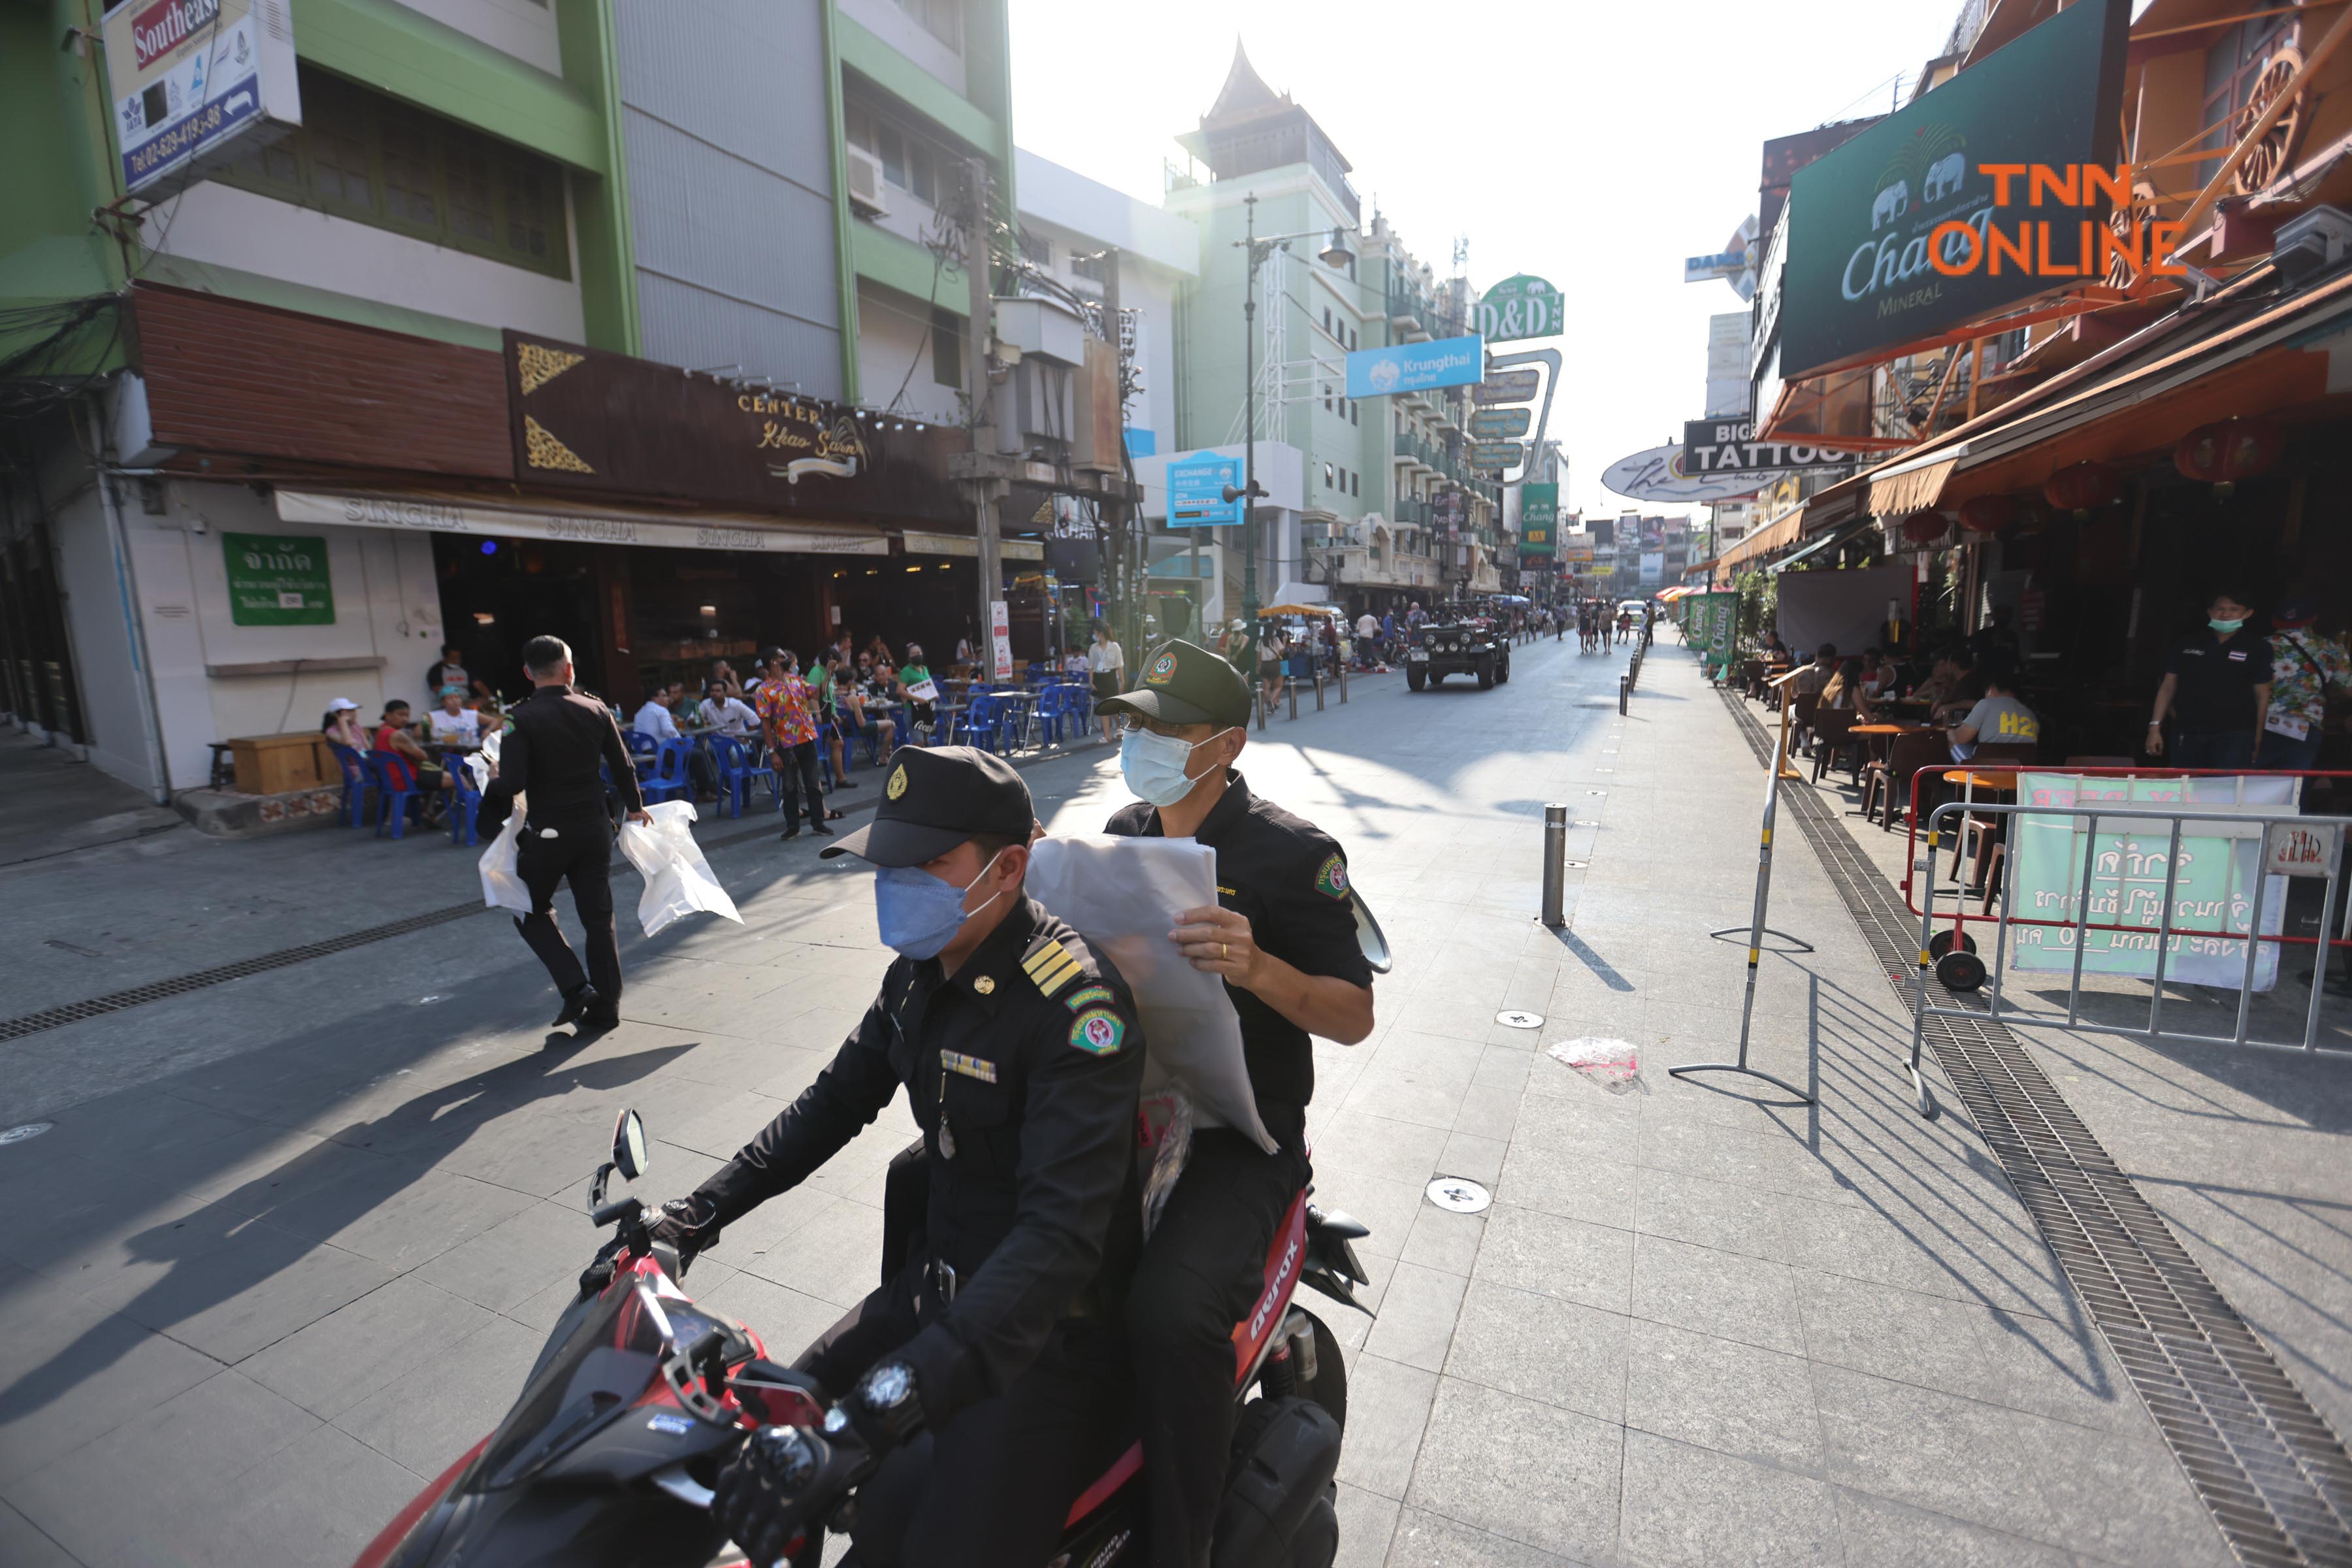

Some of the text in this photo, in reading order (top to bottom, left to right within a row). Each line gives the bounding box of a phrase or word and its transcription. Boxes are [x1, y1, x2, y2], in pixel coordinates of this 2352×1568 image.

[1478, 297, 1548, 339] D&D
[1404, 351, 1470, 373] Krungthai
[738, 395, 819, 424] CENTER
[756, 419, 859, 457] Khao Sarn
[1716, 423, 1750, 442] BIG
[1695, 442, 1847, 470] TATTOO
[343, 497, 468, 531] SINGHA
[546, 515, 638, 542] SINGHA
[1522, 510, 1555, 523] Chang
[696, 528, 765, 548] SINGHA
[243, 542, 312, 571] จำกัด
[1693, 604, 1706, 639] Chang
[1712, 605, 1731, 651] Chang
[1090, 1535, 1119, 1568] IQUID
